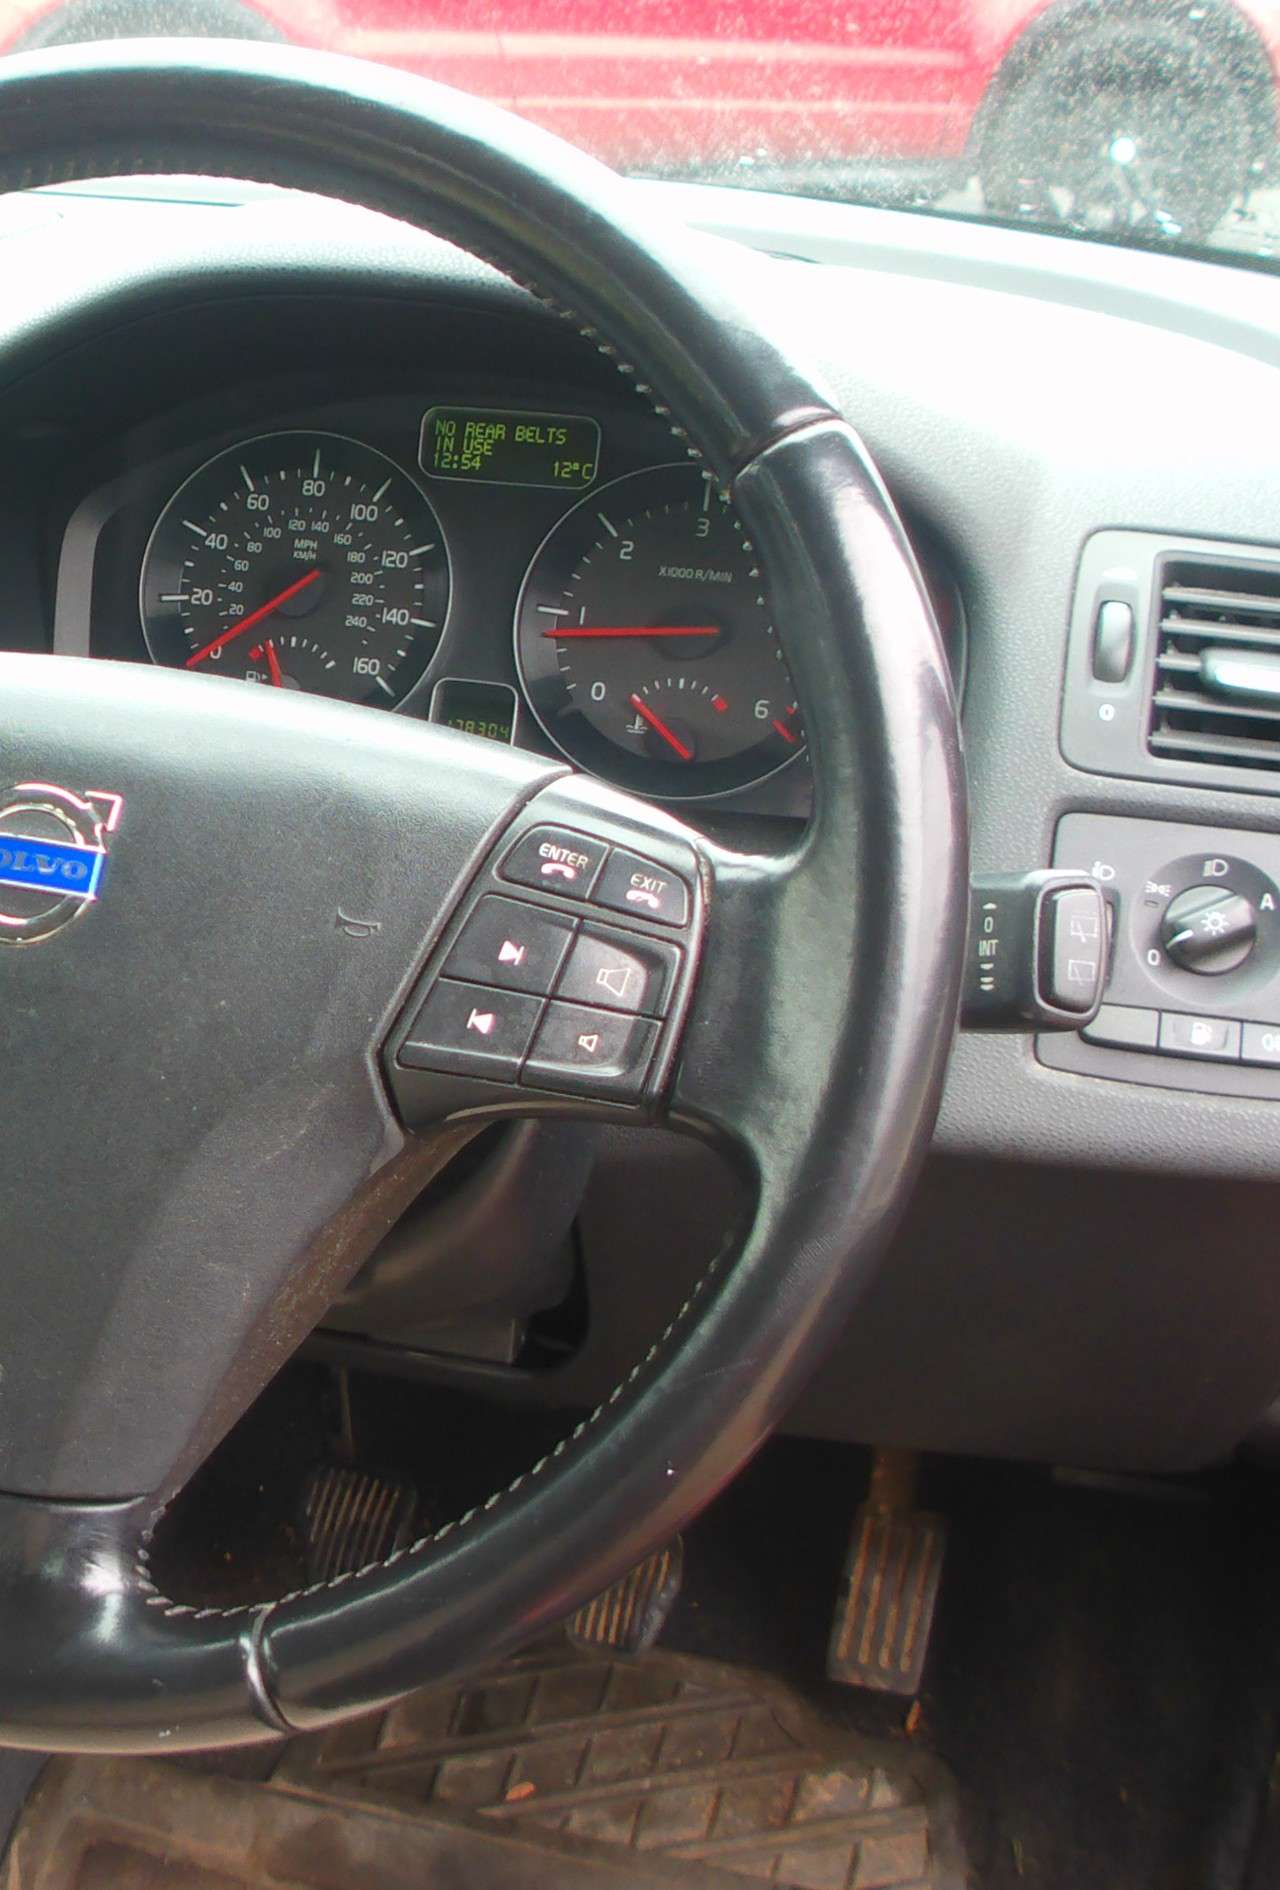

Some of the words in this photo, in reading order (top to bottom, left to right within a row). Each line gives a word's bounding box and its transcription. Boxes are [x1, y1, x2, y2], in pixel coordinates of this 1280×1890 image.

[435, 419, 456, 436] NO
[465, 422, 506, 440] REAR
[515, 425, 567, 445] BELTS
[436, 437, 454, 452] IN
[464, 438, 494, 455] USE
[433, 454, 482, 470] 12:54
[302, 480, 325, 497] 80
[247, 494, 269, 511] 60
[350, 503, 378, 522] 100
[263, 527, 281, 538] 100
[288, 520, 306, 531] 120
[311, 521, 330, 533] 140
[695, 518, 711, 537] 3
[205, 533, 228, 550] 40
[294, 539, 318, 550] MPH
[334, 533, 352, 545] 160
[247, 542, 262, 553] 80
[619, 541, 634, 560] 2
[234, 560, 249, 571] 60
[347, 552, 366, 563] 180
[382, 551, 408, 569] 120
[350, 573, 374, 584] 200
[228, 582, 243, 592] 40
[190, 589, 213, 605] 20
[352, 594, 374, 606] 220
[229, 604, 244, 615] 20
[382, 608, 409, 624] 140
[345, 616, 367, 627] 240
[353, 657, 380, 676] 160
[591, 682, 606, 701] 0
[754, 700, 770, 719] 6
[448, 719, 510, 739] 78304
[538, 842, 588, 869] ENTER
[630, 872, 668, 893] EXIT
[1260, 893, 1275, 910] A
[979, 940, 998, 956] INT
